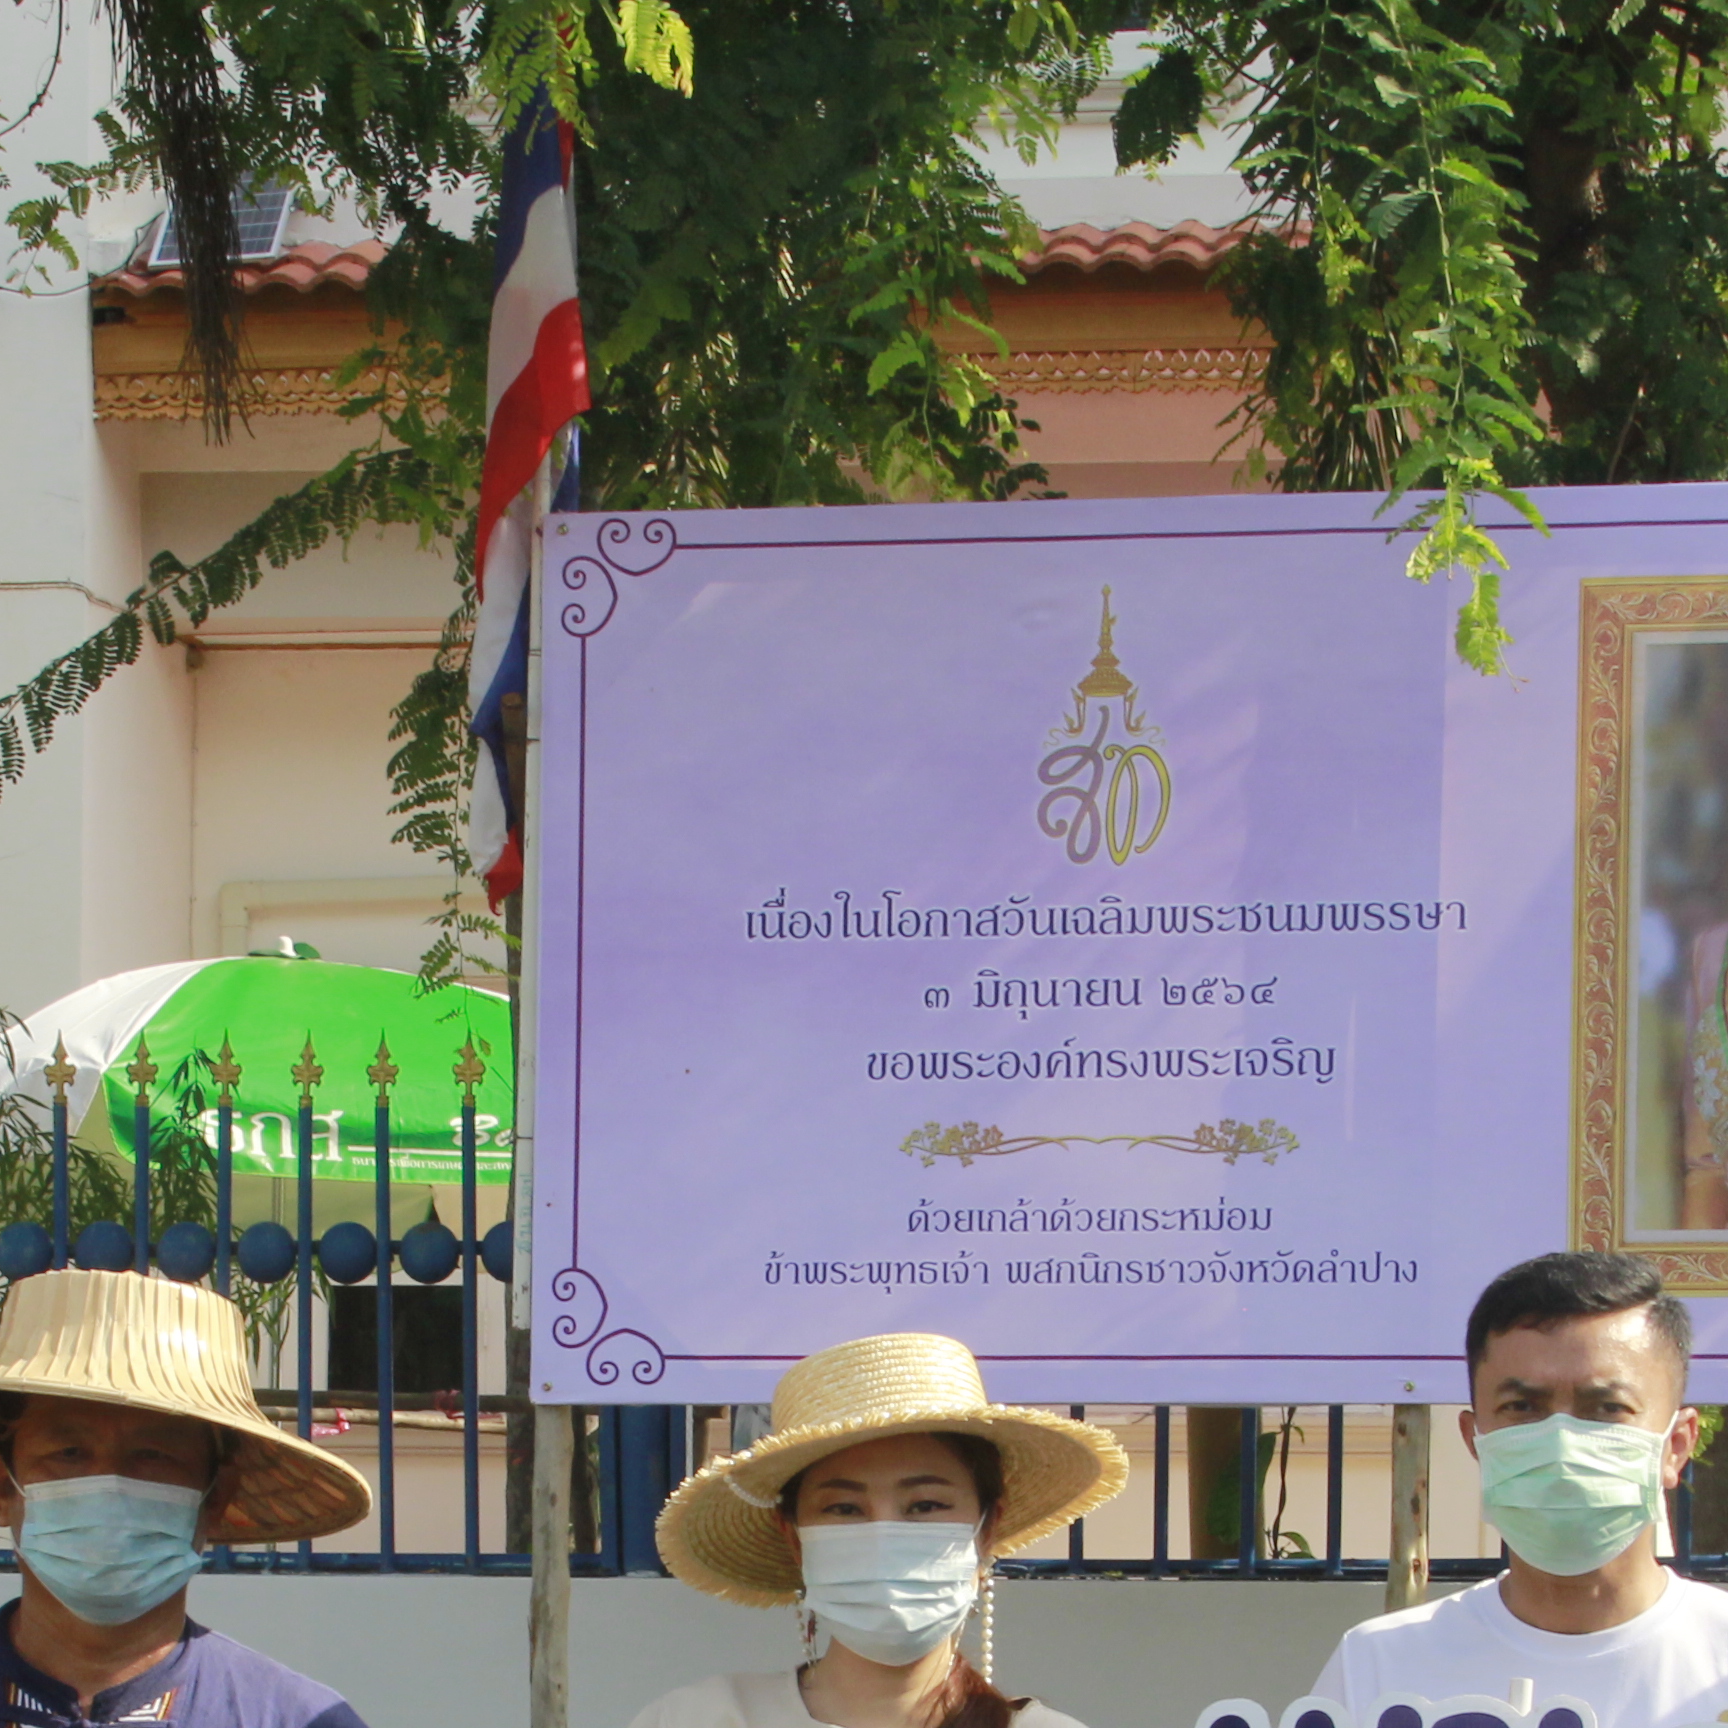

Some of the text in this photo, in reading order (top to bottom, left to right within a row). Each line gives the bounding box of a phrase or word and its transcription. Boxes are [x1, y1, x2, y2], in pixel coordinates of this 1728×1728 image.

[746, 887, 1467, 941] เนื่องในโอกาสวันเฉลิมพระชนมพรรษา
[924, 969, 1279, 1020] ๓ มิถุนายน ๒๕๖๔
[867, 1037, 1336, 1085] ขอพระองค์ทรงพระเจริญ
[907, 1196, 1272, 1234] ด้วยเกล้าด้วยกระหม่อม
[765, 1248, 1418, 1295] ข้าพระพุทธเจ้า พสกนิกรชาวจังหวัดลำปาง
